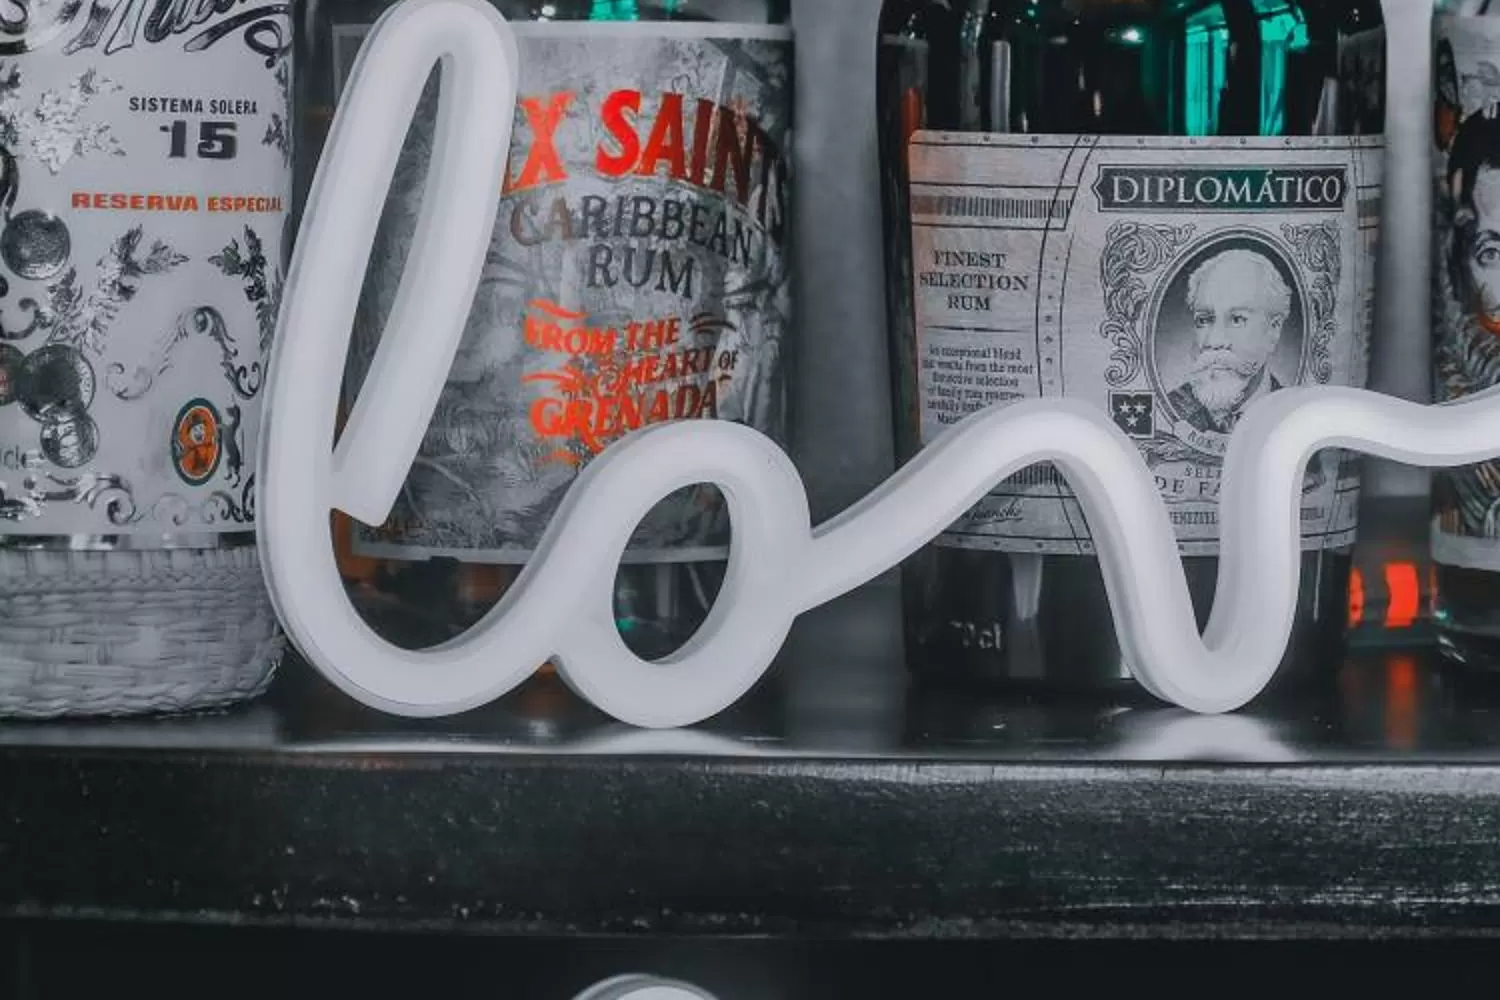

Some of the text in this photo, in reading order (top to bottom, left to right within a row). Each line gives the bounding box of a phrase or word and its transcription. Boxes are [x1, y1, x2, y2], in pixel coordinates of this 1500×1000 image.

[129, 97, 258, 115] SISTEMA SOLERA
[159, 120, 238, 160] 15
[71, 193, 284, 214] RESERVA ESPECIAL
[1112, 169, 1342, 204] DIPLOMÁTICO
[510, 195, 752, 268] CARIBBEAN
[588, 243, 695, 299] RUM
[933, 250, 1007, 269] FINEST
[919, 272, 1029, 291] SELECTION
[947, 295, 992, 312] RUM
[523, 313, 681, 356] FROM THE
[622, 348, 740, 386] HEART OF
[529, 379, 720, 453] GRENADA
